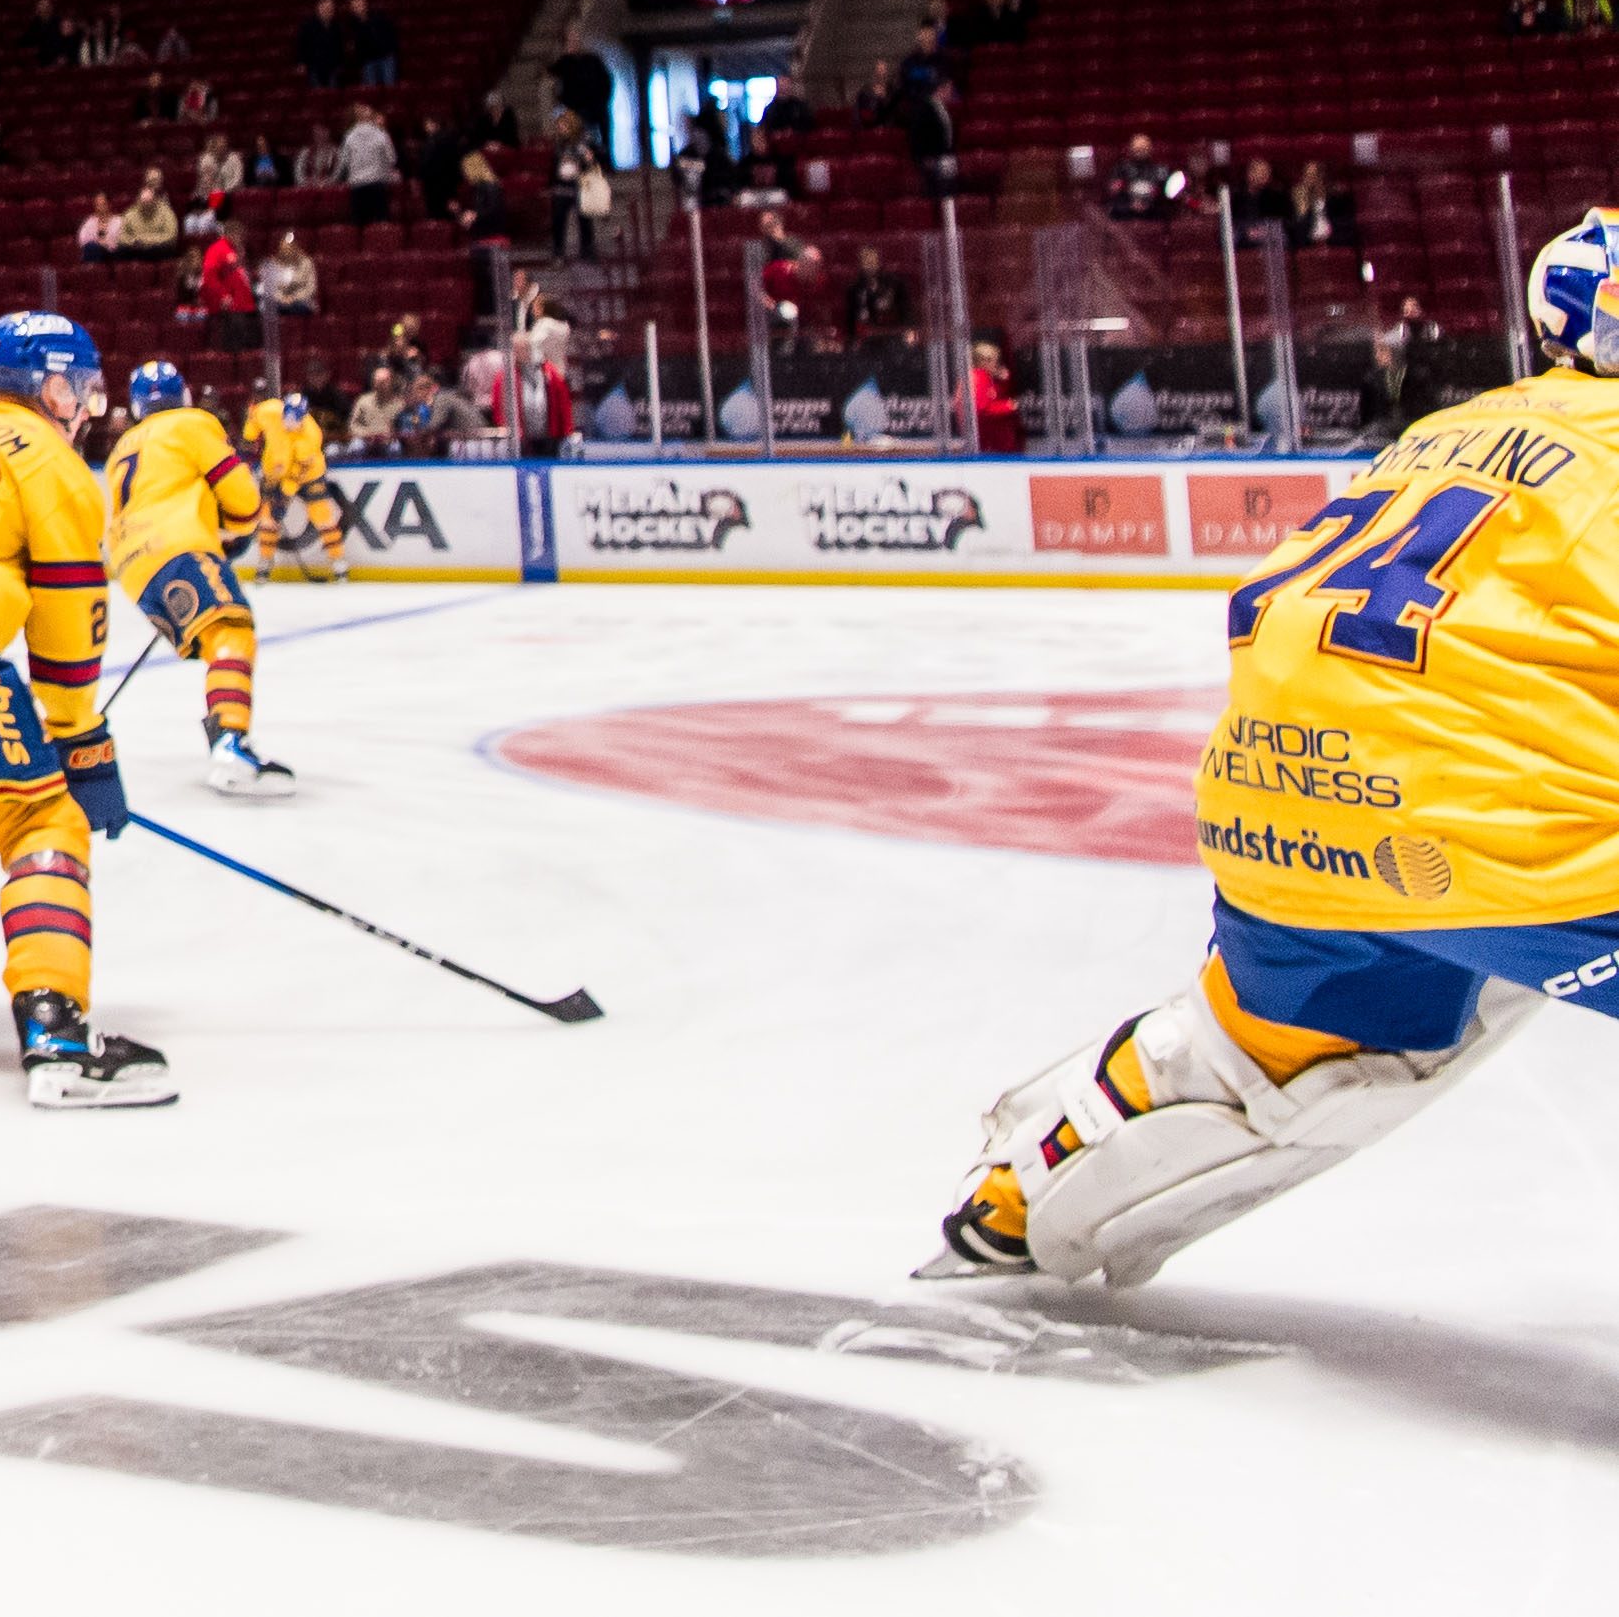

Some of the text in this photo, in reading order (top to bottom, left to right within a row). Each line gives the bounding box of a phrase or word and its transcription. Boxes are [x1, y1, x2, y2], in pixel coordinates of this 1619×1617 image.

[584, 512, 719, 548] HOCKEY
[808, 512, 951, 549] HOCKEY
[1041, 521, 1158, 546] DAMPF
[1201, 521, 1299, 546] DAM
[1196, 815, 1371, 881] undström
[1541, 946, 1619, 999] CC
